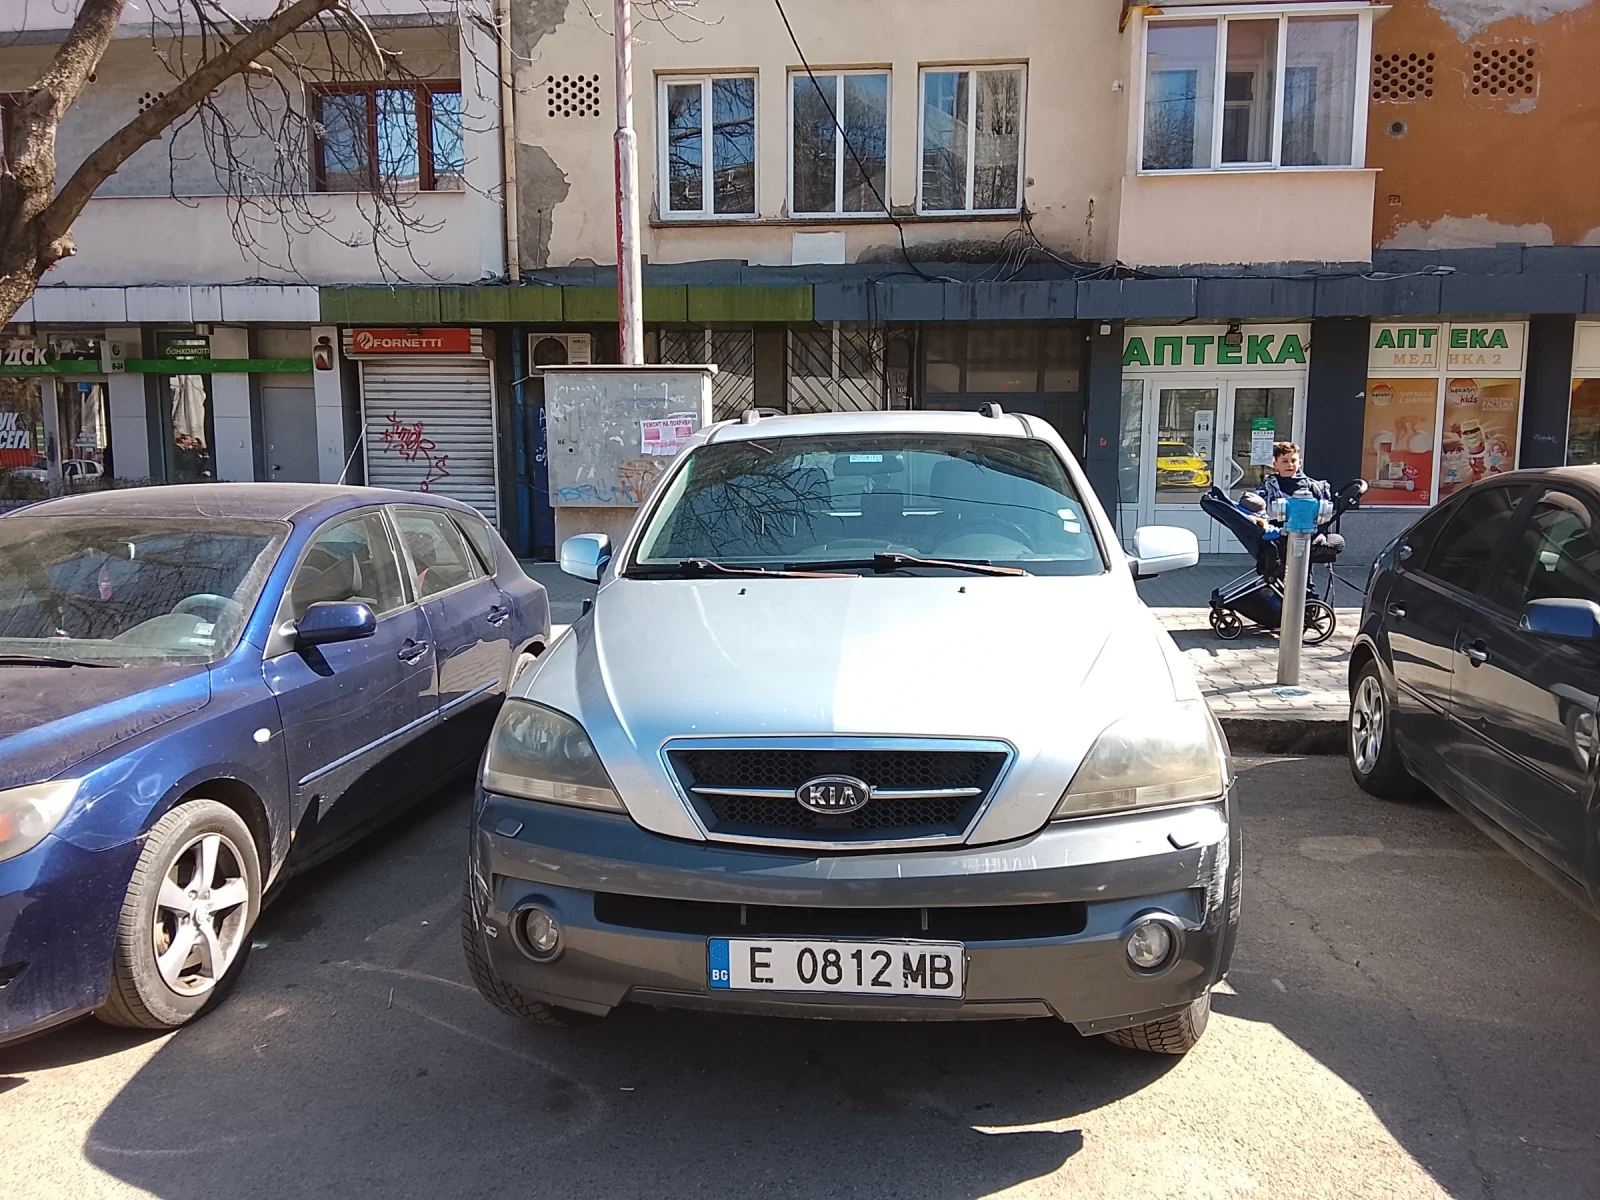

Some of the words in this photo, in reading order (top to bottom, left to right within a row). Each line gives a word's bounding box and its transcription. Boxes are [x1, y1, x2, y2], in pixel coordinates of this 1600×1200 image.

[373, 338, 442, 348] FORNETTI
[1375, 328, 1509, 349] АПТЕКА
[166, 346, 210, 355] банкомат
[1121, 334, 1307, 367] АПТЕКА
[1492, 354, 1502, 365] 2
[1460, 394, 1479, 404] kids
[808, 786, 858, 805] KIA
[750, 946, 774, 984] E
[796, 947, 893, 988] 0812
[902, 951, 954, 990] MB
[712, 969, 728, 980] BG
